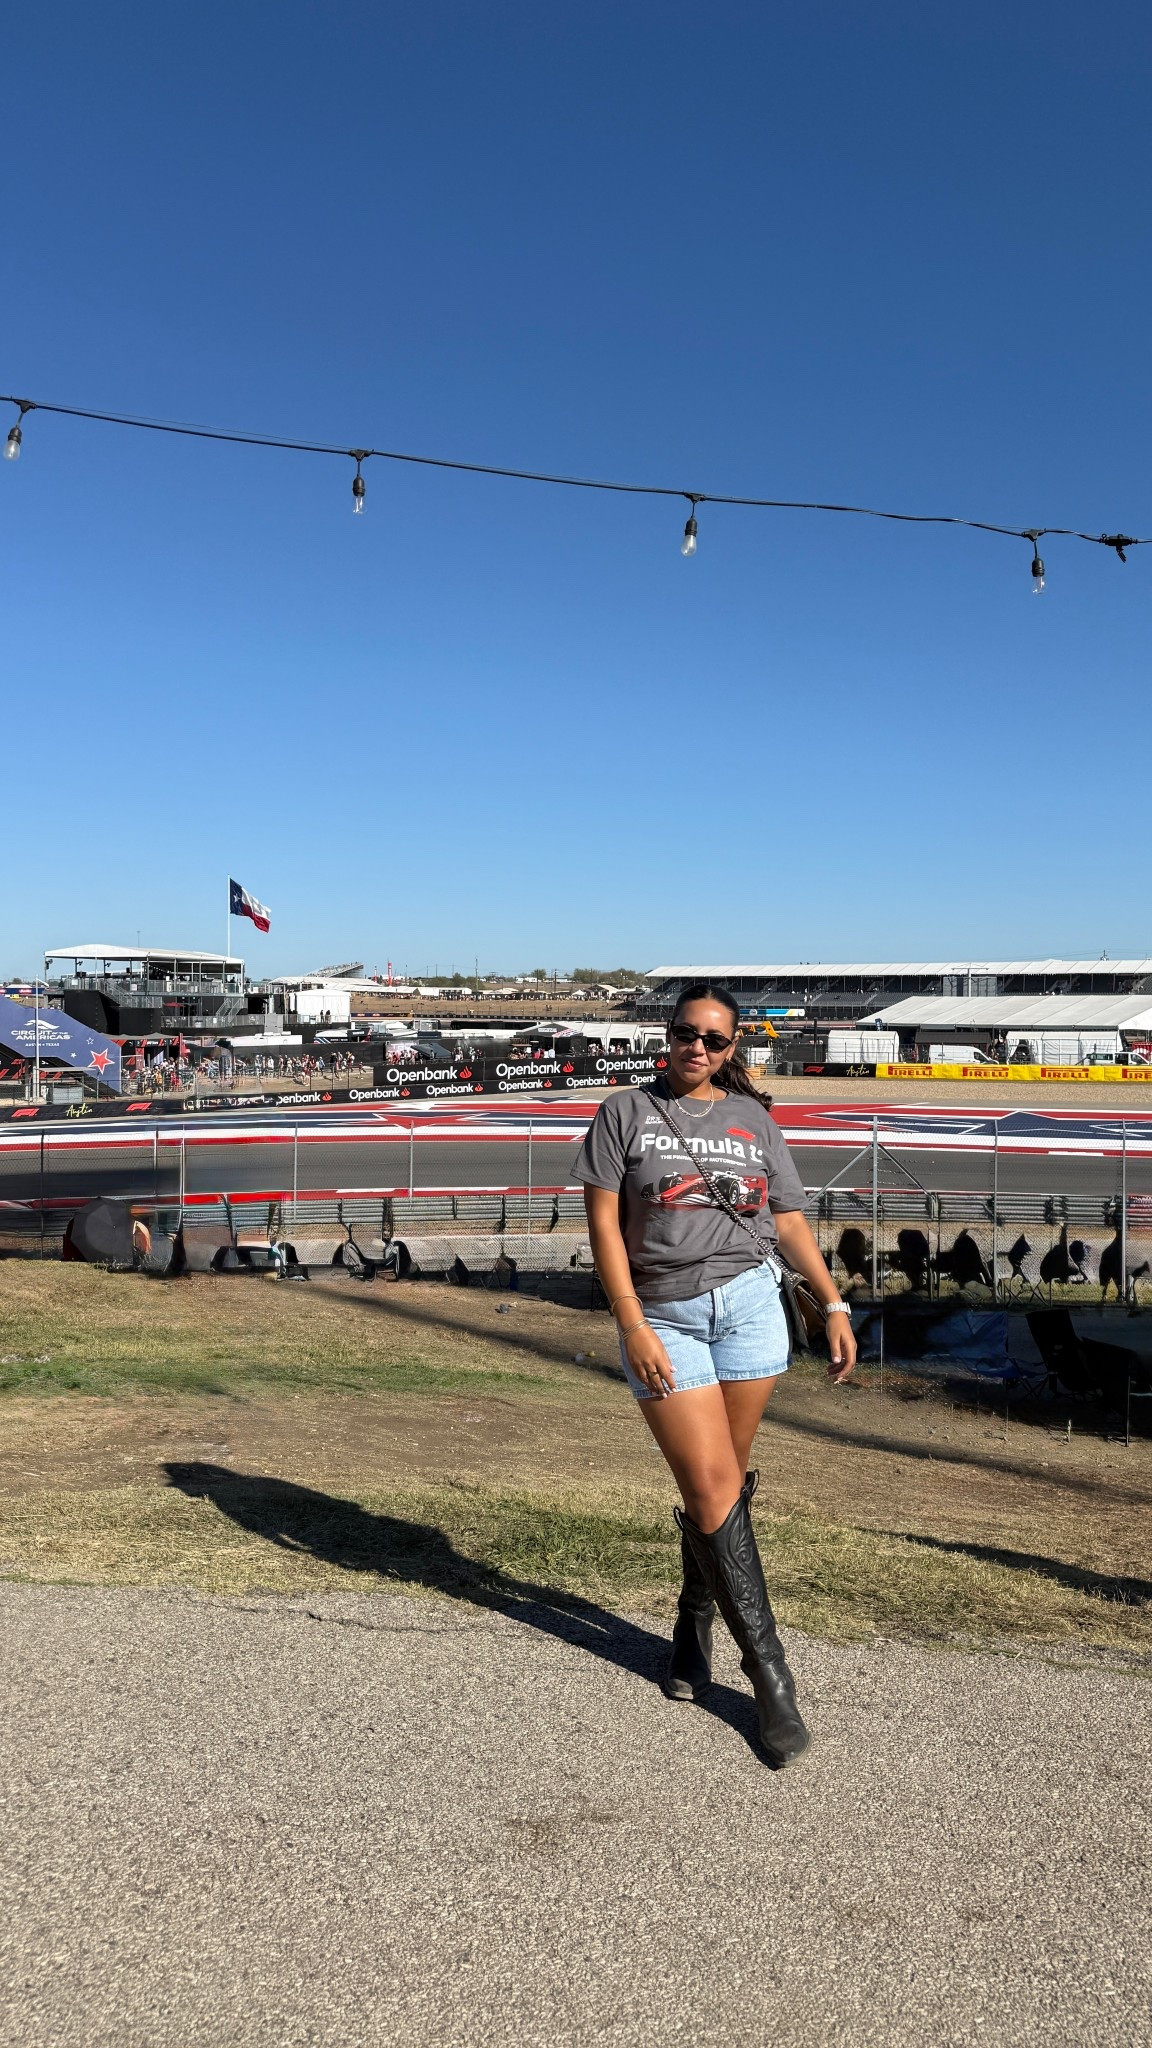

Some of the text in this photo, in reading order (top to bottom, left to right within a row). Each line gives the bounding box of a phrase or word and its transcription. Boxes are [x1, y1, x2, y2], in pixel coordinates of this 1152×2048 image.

[496, 1061, 561, 1079] Openbank
[596, 1057, 655, 1074] Openbank
[888, 1065, 933, 1076] PIRELLI
[962, 1066, 1010, 1078] PIRELLI
[386, 1066, 458, 1086] Openbank
[630, 1073, 657, 1087] Openb
[1040, 1067, 1090, 1079] PIRELLI
[1122, 1068, 1152, 1079] PIRE
[426, 1081, 474, 1096] Openbank
[498, 1079, 544, 1092] Openbank
[566, 1076, 609, 1088] Openbank
[276, 1091, 321, 1106] penbank
[349, 1087, 400, 1101] Openbank
[640, 1134, 746, 1158] Formula
